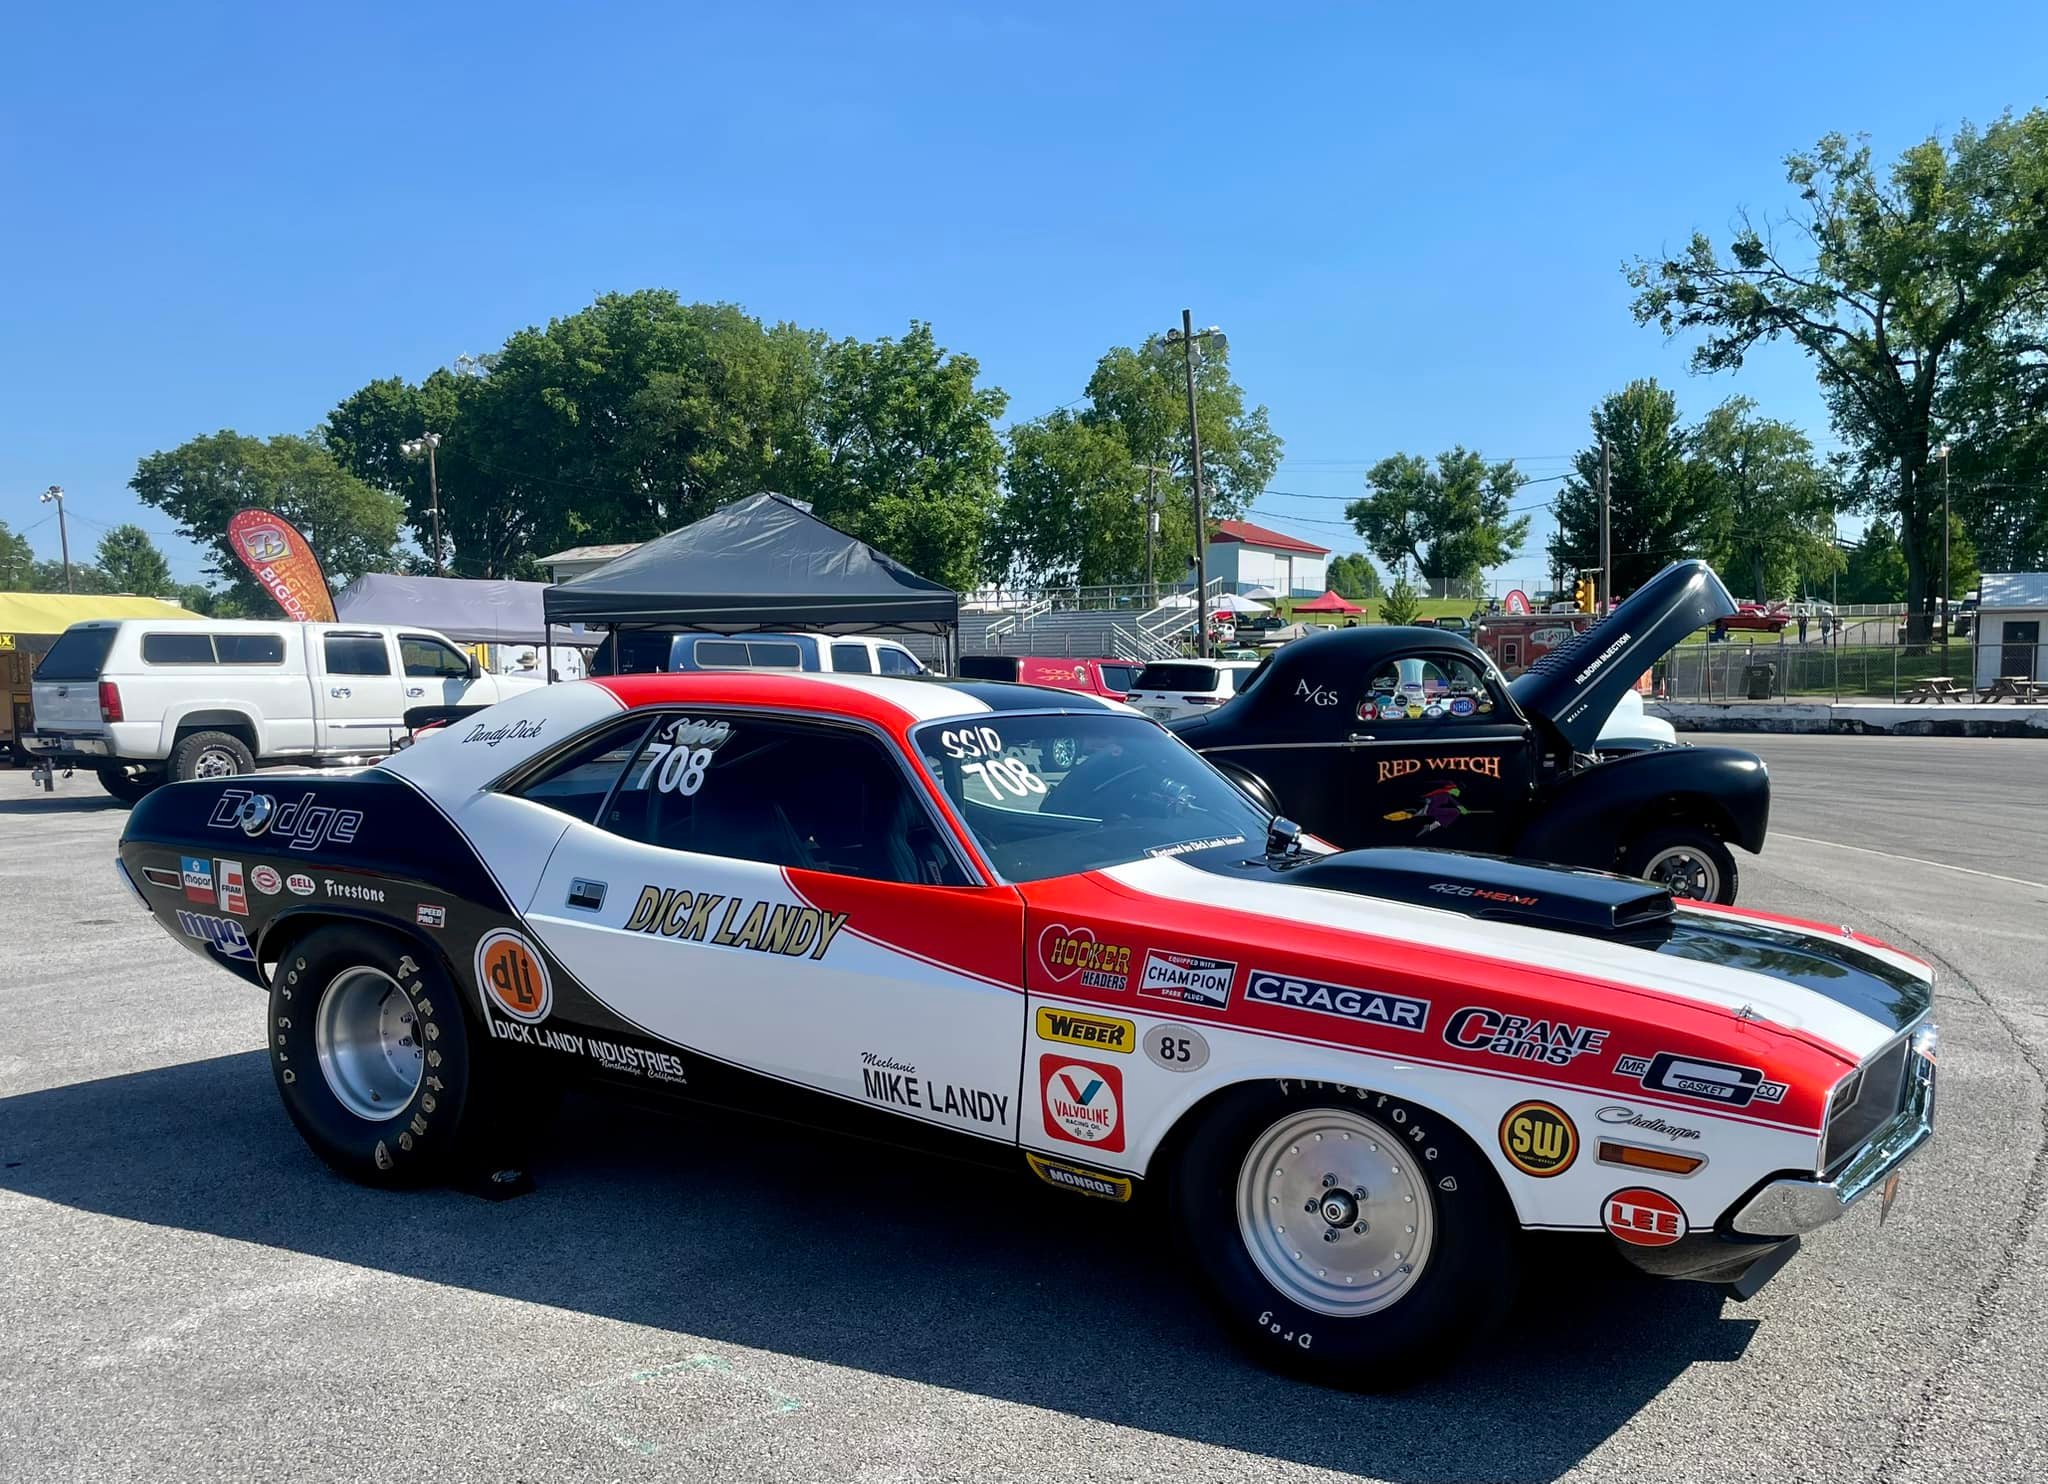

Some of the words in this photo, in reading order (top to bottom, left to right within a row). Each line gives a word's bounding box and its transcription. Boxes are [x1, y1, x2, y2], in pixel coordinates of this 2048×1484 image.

[1574, 658, 1604, 685] HILBORN
[1600, 632, 1632, 665] INJECTION
[1295, 679, 1338, 706] A/GS
[462, 723, 510, 748] Dandy
[509, 719, 547, 740] Dick
[941, 727, 1001, 759] SS/D
[637, 743, 712, 797] 708
[960, 757, 1047, 801] 708
[1376, 758, 1422, 784] RED
[1426, 756, 1501, 779] WITCH
[221, 884, 241, 894] FRAM
[290, 877, 314, 889] BELL
[324, 879, 385, 902] Firestone
[1428, 882, 1475, 897] 426
[1474, 889, 1539, 906] HEMI
[418, 907, 442, 916] SPEED
[418, 915, 434, 924] PRO
[625, 885, 722, 940] DICK
[712, 897, 852, 960] LANDY
[1050, 937, 1132, 974] HOOKER
[1168, 955, 1198, 967] EQUIPPED
[1199, 960, 1217, 969] WITH
[1081, 970, 1128, 992] HEADERS
[1148, 966, 1228, 993] CHAMPION
[1161, 988, 1182, 998] SPARK
[1183, 992, 1205, 1002] PLUGS
[1253, 977, 1421, 1026] CRAGAR
[1045, 1013, 1125, 1046] WEBER
[1443, 1007, 1609, 1053] CRANE
[495, 1019, 535, 1045] DICK
[534, 1027, 584, 1055] LANDY
[588, 1038, 684, 1076] INDUSTRIES
[1160, 1036, 1191, 1062] 85
[861, 1051, 917, 1074] Mechanic
[1621, 1059, 1646, 1074] MR.
[862, 1068, 922, 1109] MIKE
[927, 1081, 1009, 1126] LANDY
[1677, 1079, 1726, 1096] GASKET
[1054, 1098, 1110, 1128] VALVOLINE
[1066, 1118, 1090, 1129] RACING
[1090, 1123, 1101, 1131] OIL
[1594, 1105, 1702, 1141] Challenger
[1512, 1117, 1564, 1159] SW
[1049, 1169, 1115, 1195] MONROE
[1611, 1203, 1679, 1235] LEE
